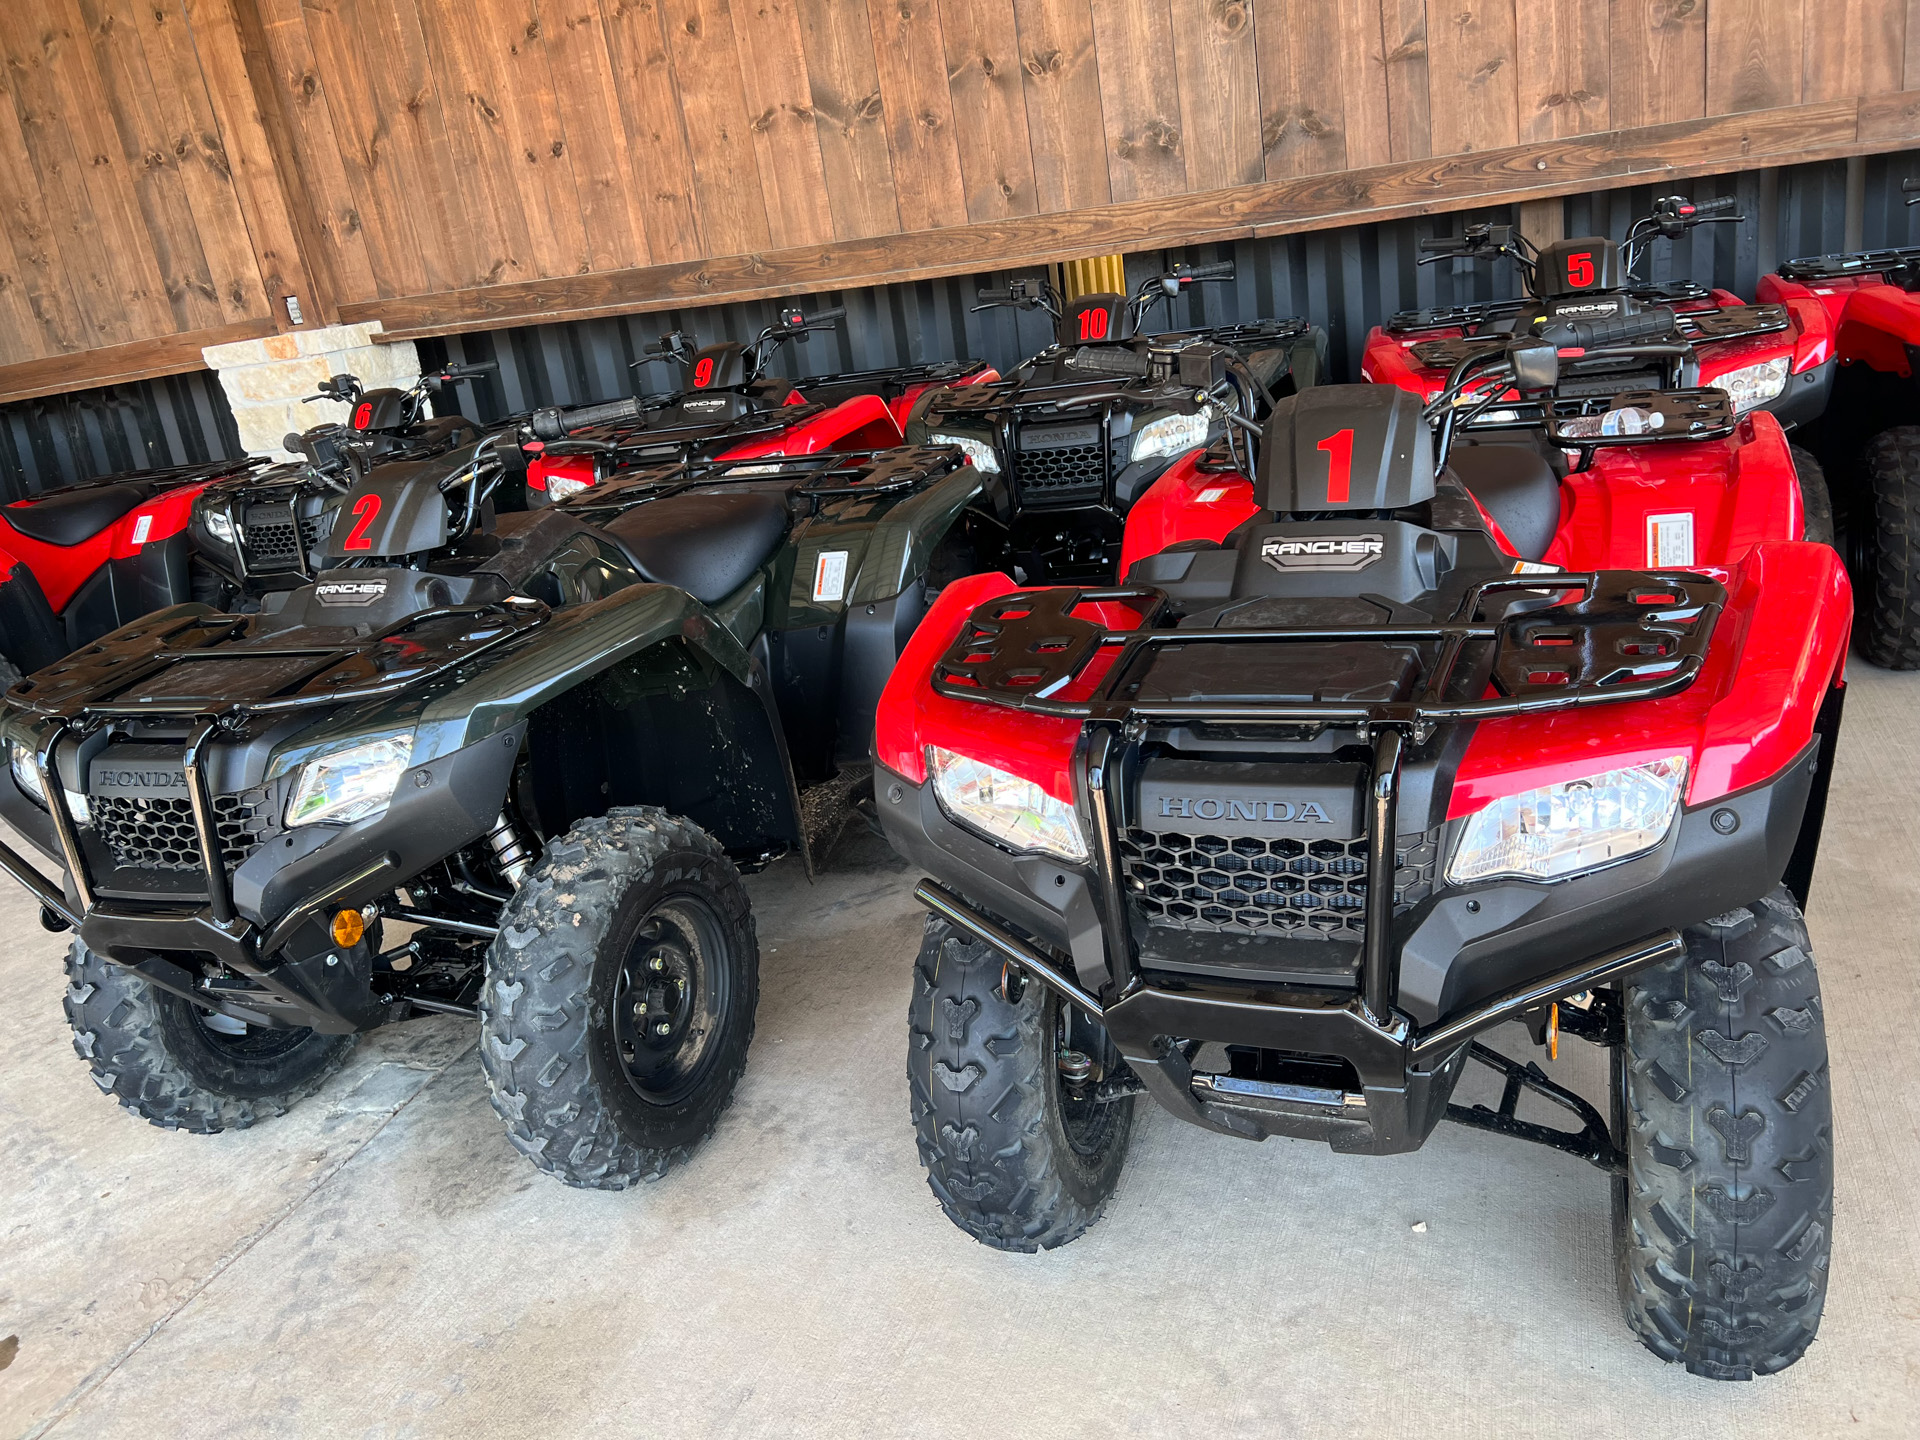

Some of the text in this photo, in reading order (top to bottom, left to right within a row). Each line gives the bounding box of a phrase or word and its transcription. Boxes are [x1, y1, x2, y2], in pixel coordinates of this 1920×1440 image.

[1568, 253, 1594, 287] 5
[1556, 300, 1619, 316] RANCHER
[1078, 308, 1108, 340] 10
[694, 358, 713, 388] 9
[355, 403, 372, 429] 6
[683, 400, 727, 410] RANCHER
[1027, 429, 1092, 445] HONDA
[1317, 429, 1354, 502] 1
[250, 510, 291, 521] HONDA
[344, 493, 382, 551] 2
[1261, 537, 1384, 557] RANCHER
[315, 583, 388, 597] RANCHER
[99, 770, 188, 787] HONDA
[1158, 796, 1335, 825] HONDA
